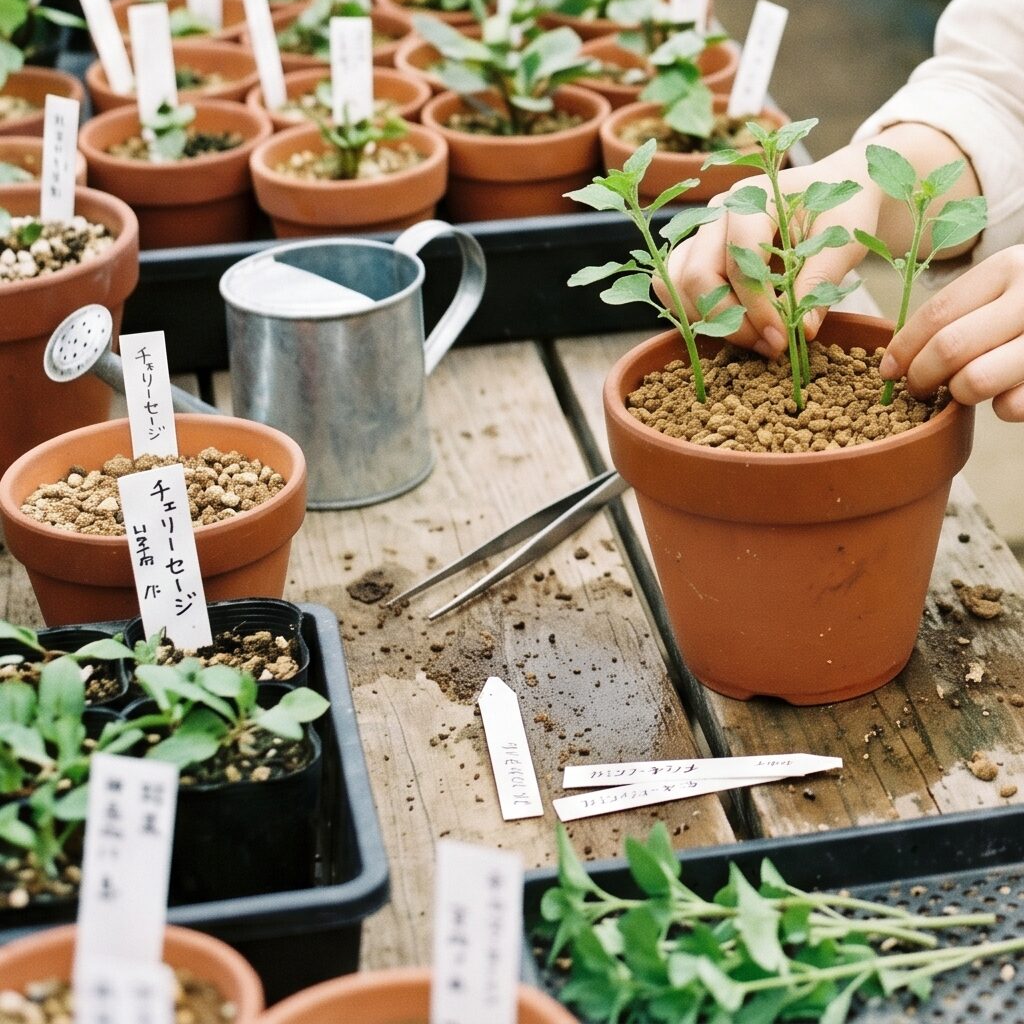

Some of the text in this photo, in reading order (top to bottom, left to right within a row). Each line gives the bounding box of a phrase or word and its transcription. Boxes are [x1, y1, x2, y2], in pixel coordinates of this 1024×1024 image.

[150, 479, 197, 616] チェリーセージ
